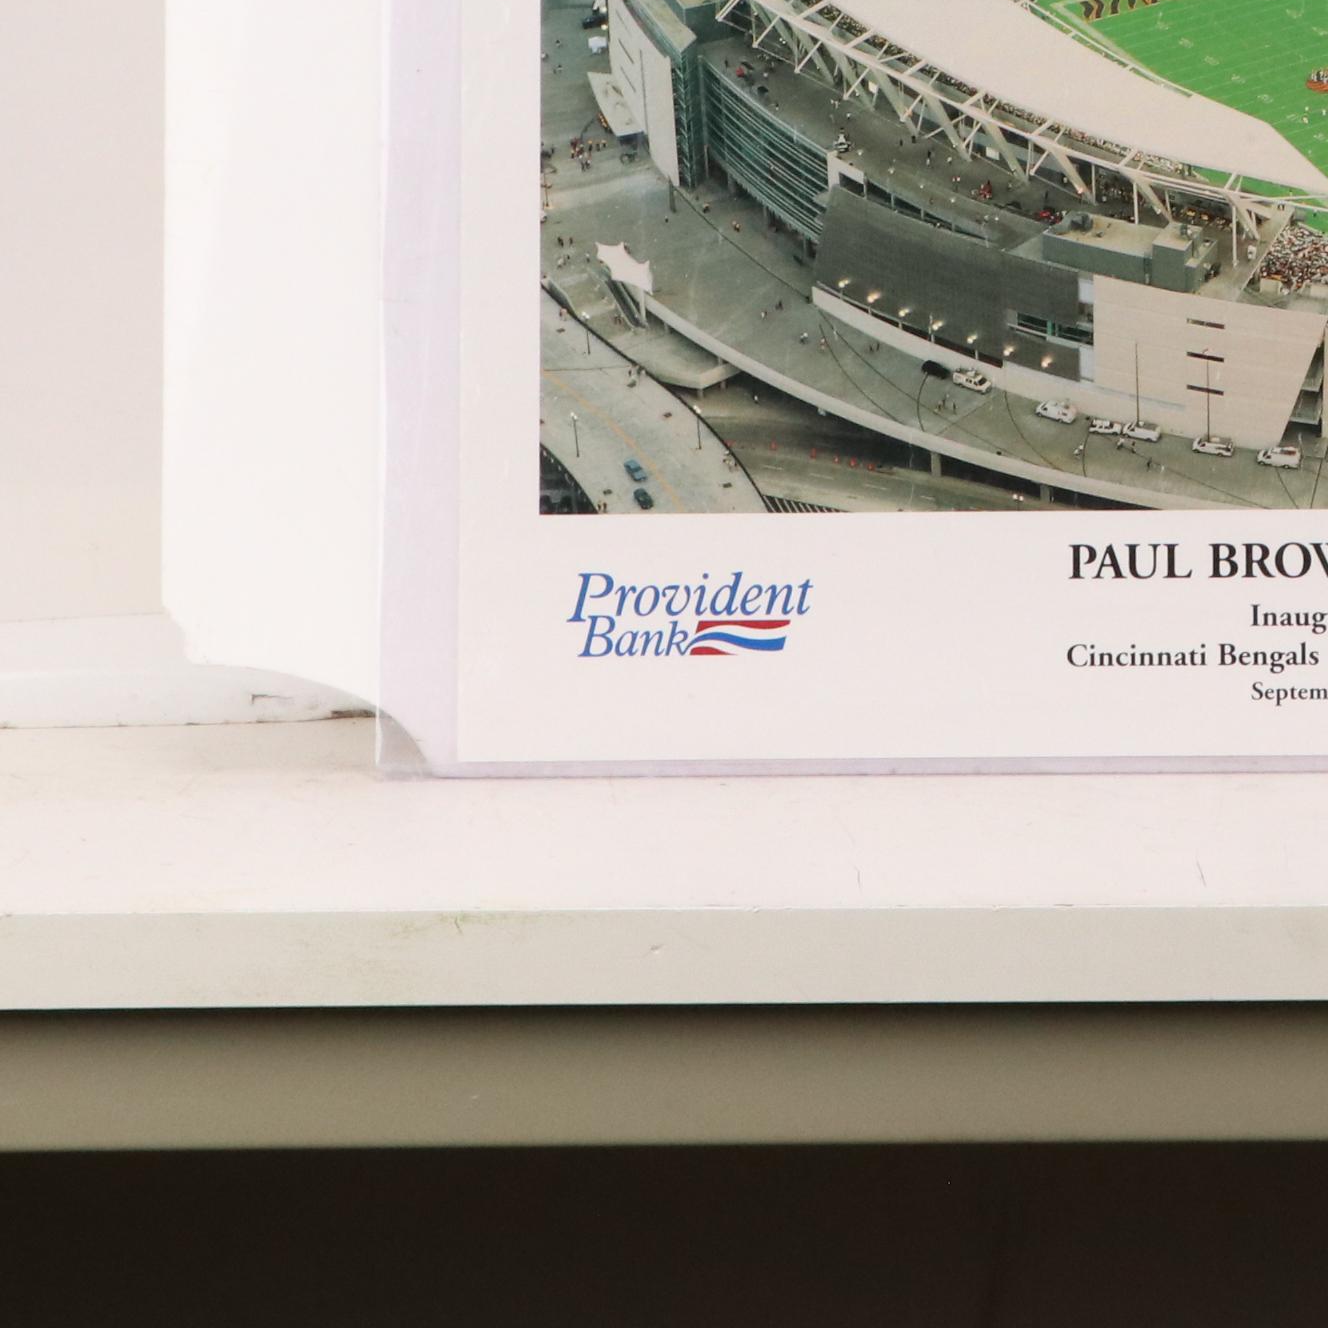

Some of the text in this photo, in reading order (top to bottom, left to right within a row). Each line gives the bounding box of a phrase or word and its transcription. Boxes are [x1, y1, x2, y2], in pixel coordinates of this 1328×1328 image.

[1069, 543, 1193, 580] PAUL
[566, 571, 814, 623] Provident
[577, 615, 691, 658] Bank
[1066, 643, 1207, 667] Cincinnati
[1218, 641, 1320, 674] Bengals
